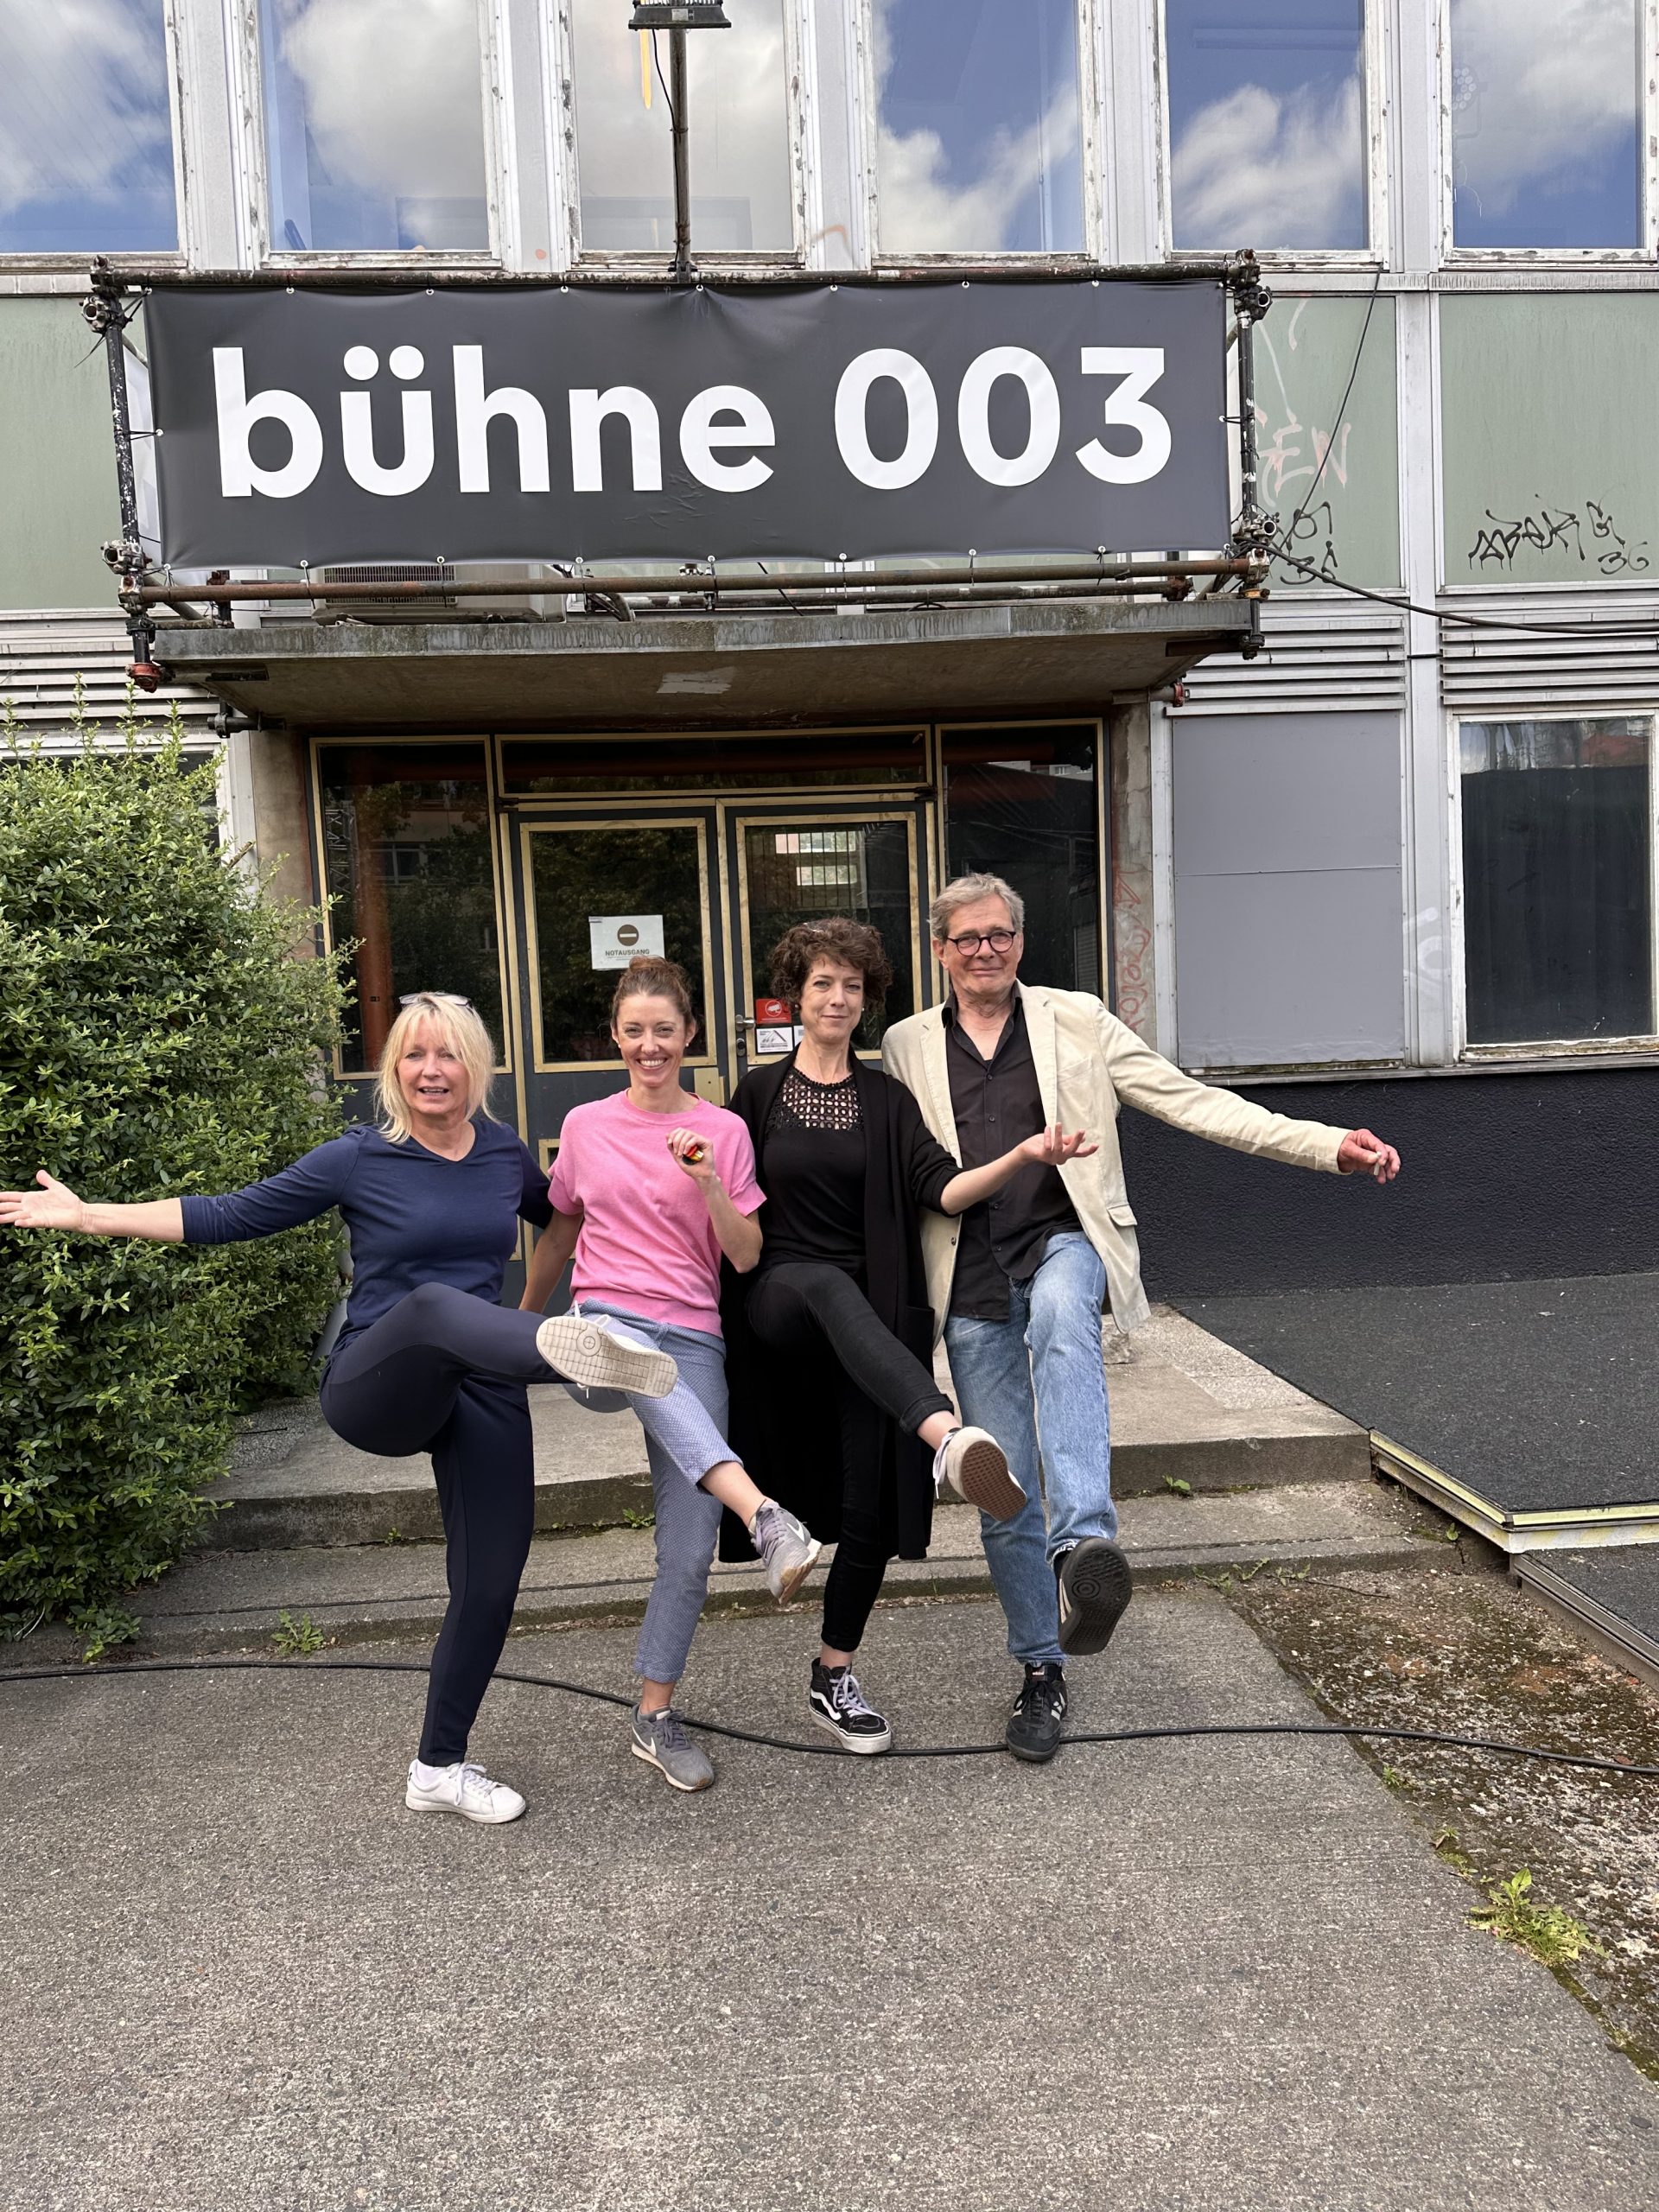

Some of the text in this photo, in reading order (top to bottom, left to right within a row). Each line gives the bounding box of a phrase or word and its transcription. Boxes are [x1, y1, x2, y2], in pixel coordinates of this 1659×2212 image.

[213, 345, 1172, 499] bühne 003
[605, 948, 651, 957] NOTAUSGANG
